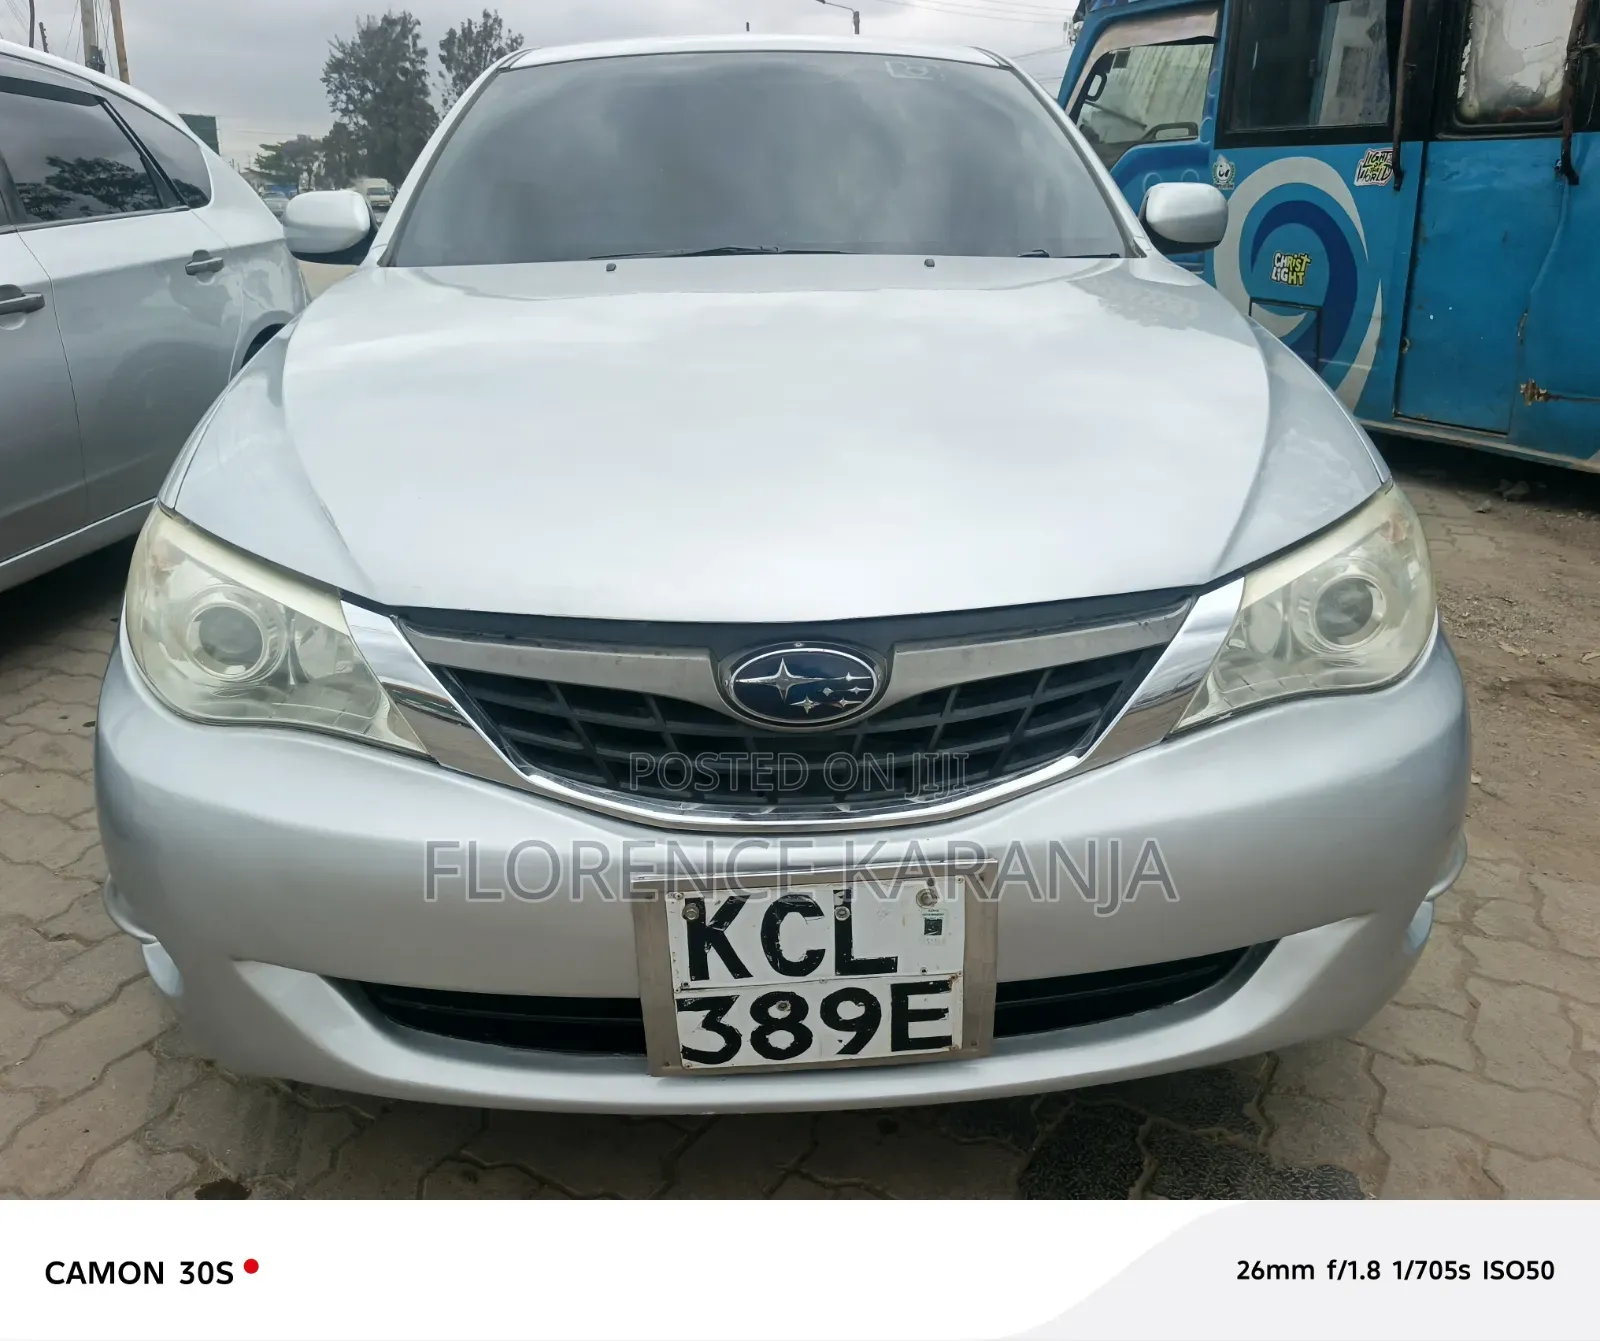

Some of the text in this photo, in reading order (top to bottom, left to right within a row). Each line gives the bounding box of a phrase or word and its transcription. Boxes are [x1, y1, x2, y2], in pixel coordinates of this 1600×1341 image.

[1356, 163, 1393, 182] WORLD
[1362, 151, 1393, 168] LIGHT
[684, 889, 898, 981] KCL
[675, 980, 953, 1064] 389E
